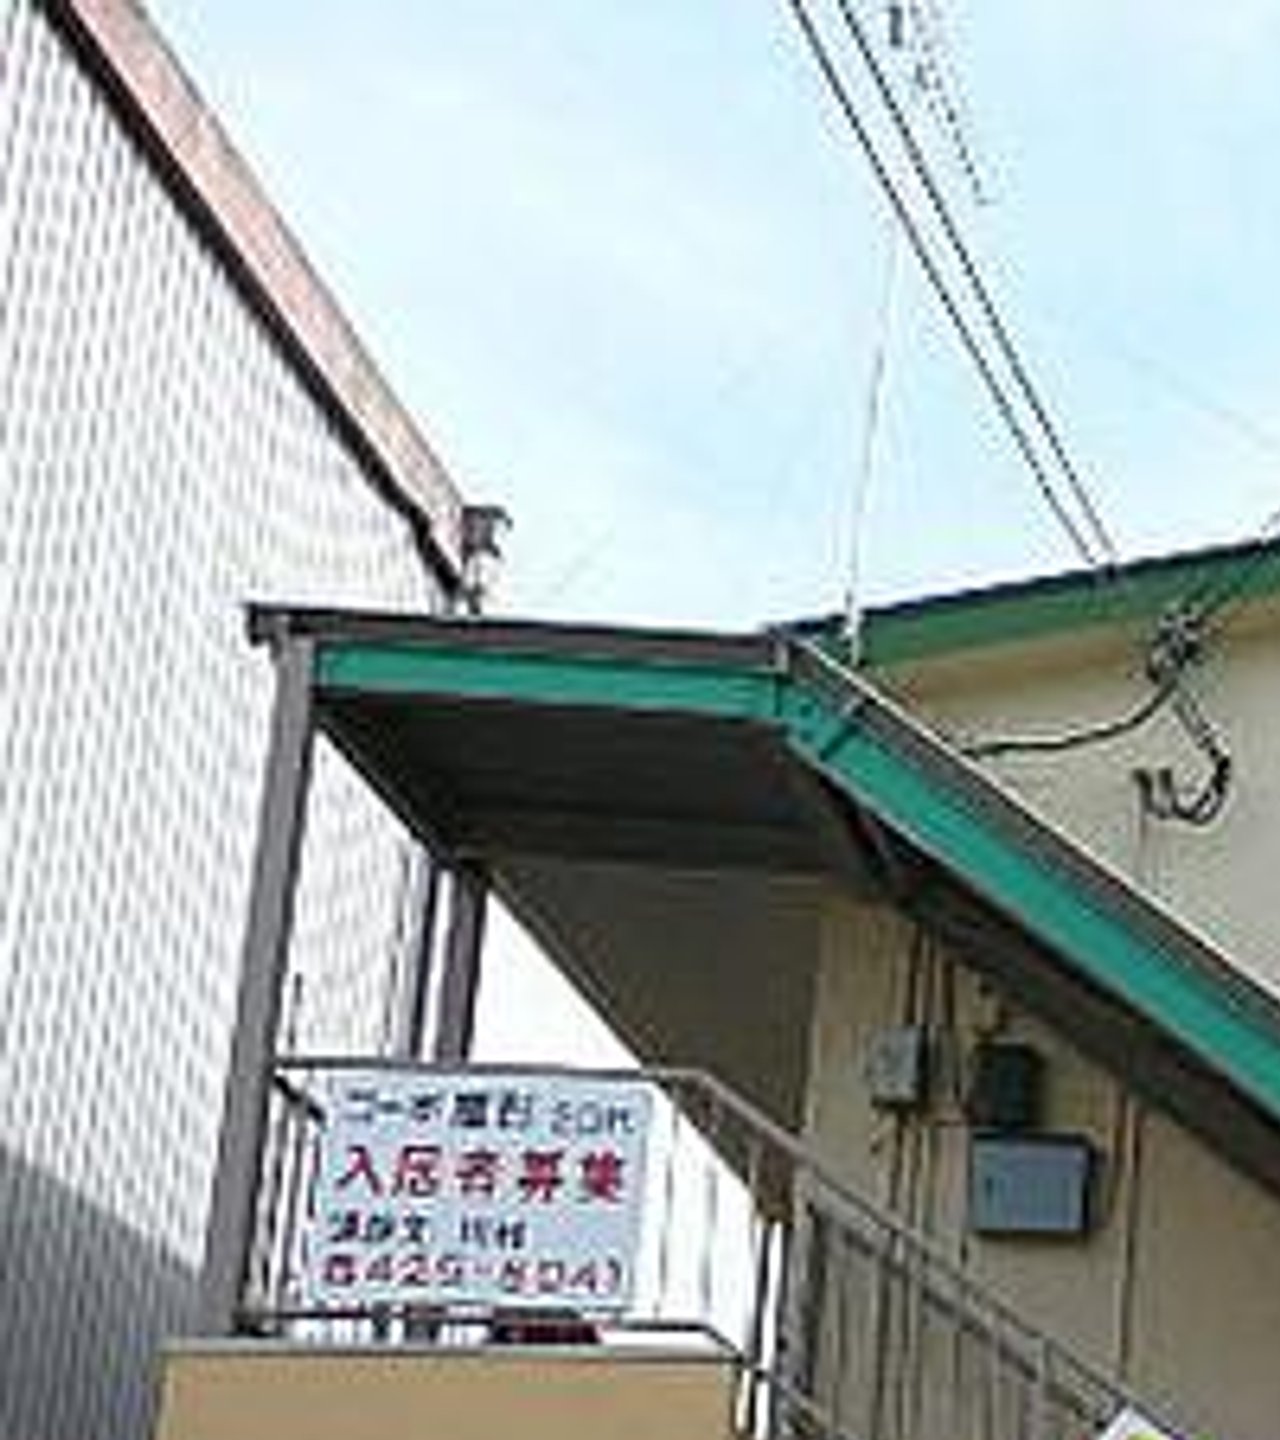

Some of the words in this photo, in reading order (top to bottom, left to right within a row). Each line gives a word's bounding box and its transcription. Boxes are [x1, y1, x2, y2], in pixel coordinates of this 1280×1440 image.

[335, 1145, 625, 1201] 入居者募集
